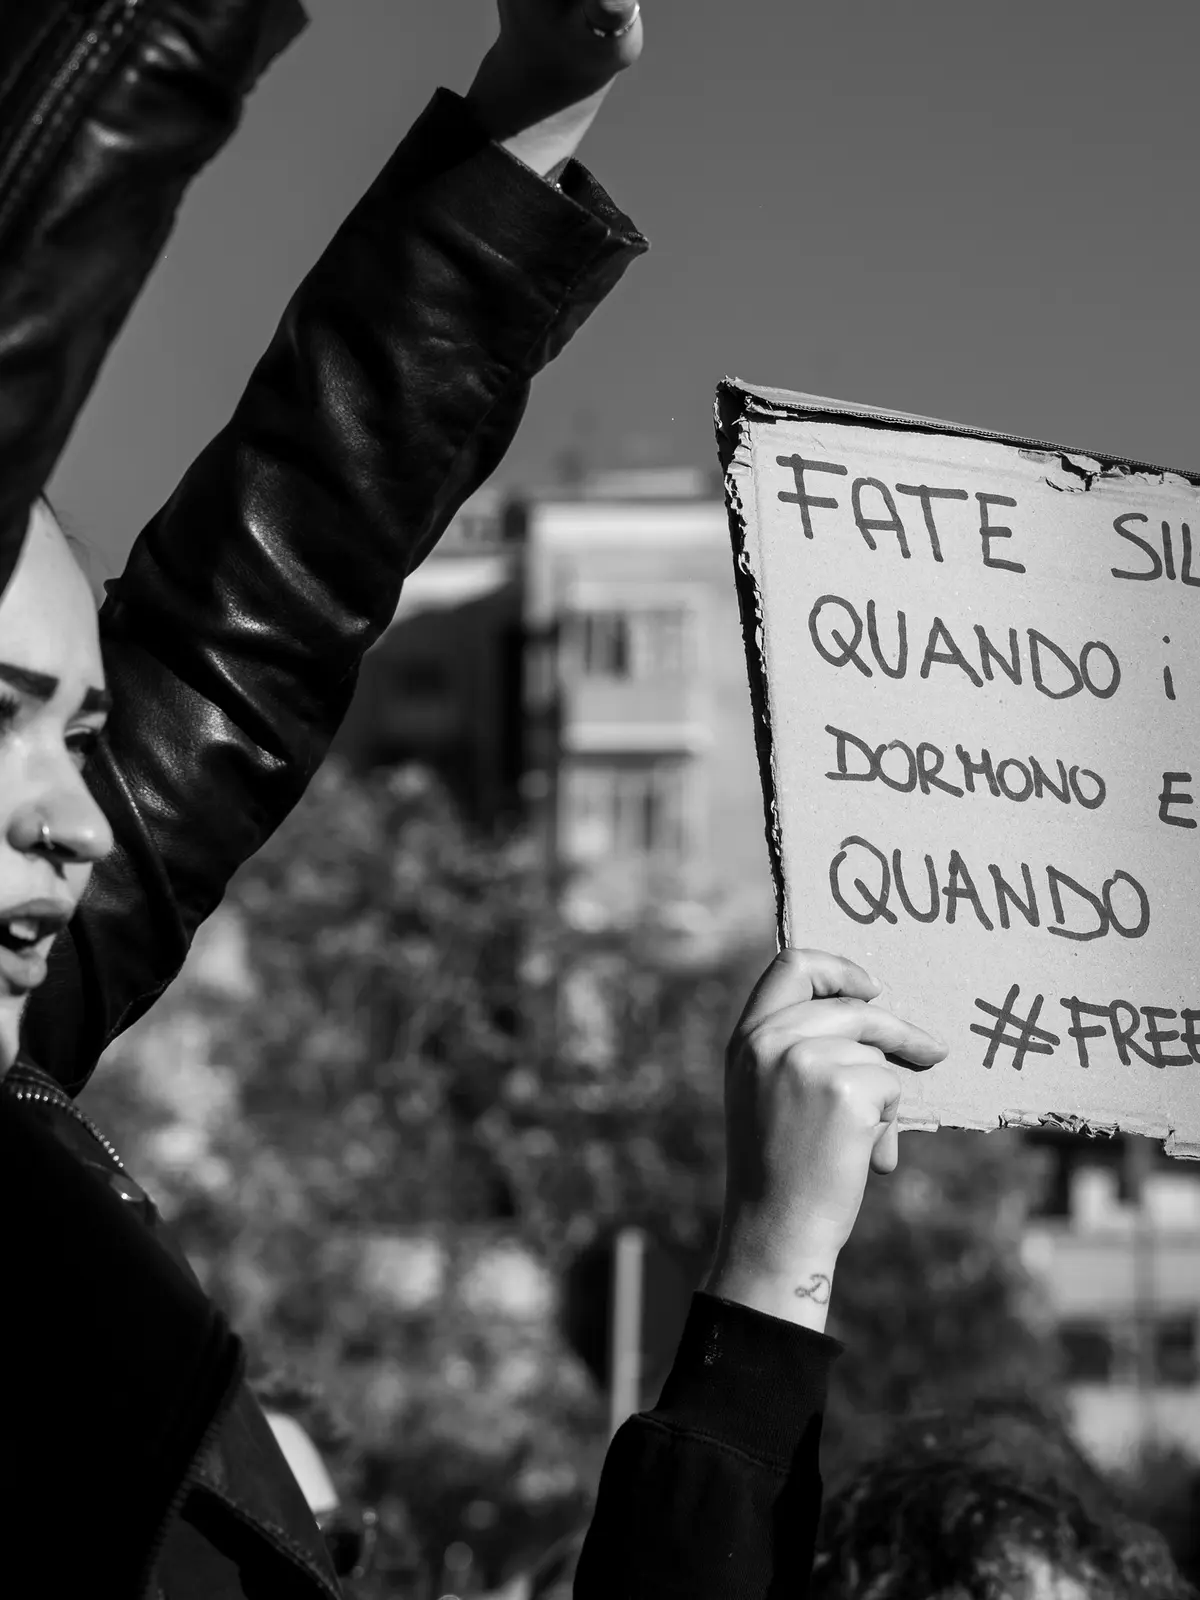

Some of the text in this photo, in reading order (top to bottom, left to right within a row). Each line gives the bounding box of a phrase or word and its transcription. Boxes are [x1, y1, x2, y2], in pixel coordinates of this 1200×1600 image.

[776, 453, 1026, 573] FATE
[808, 594, 1122, 700] QUANDO
[824, 724, 1107, 810] DORMONO
[1158, 771, 1198, 829] E
[829, 835, 1151, 941] QUANDO
